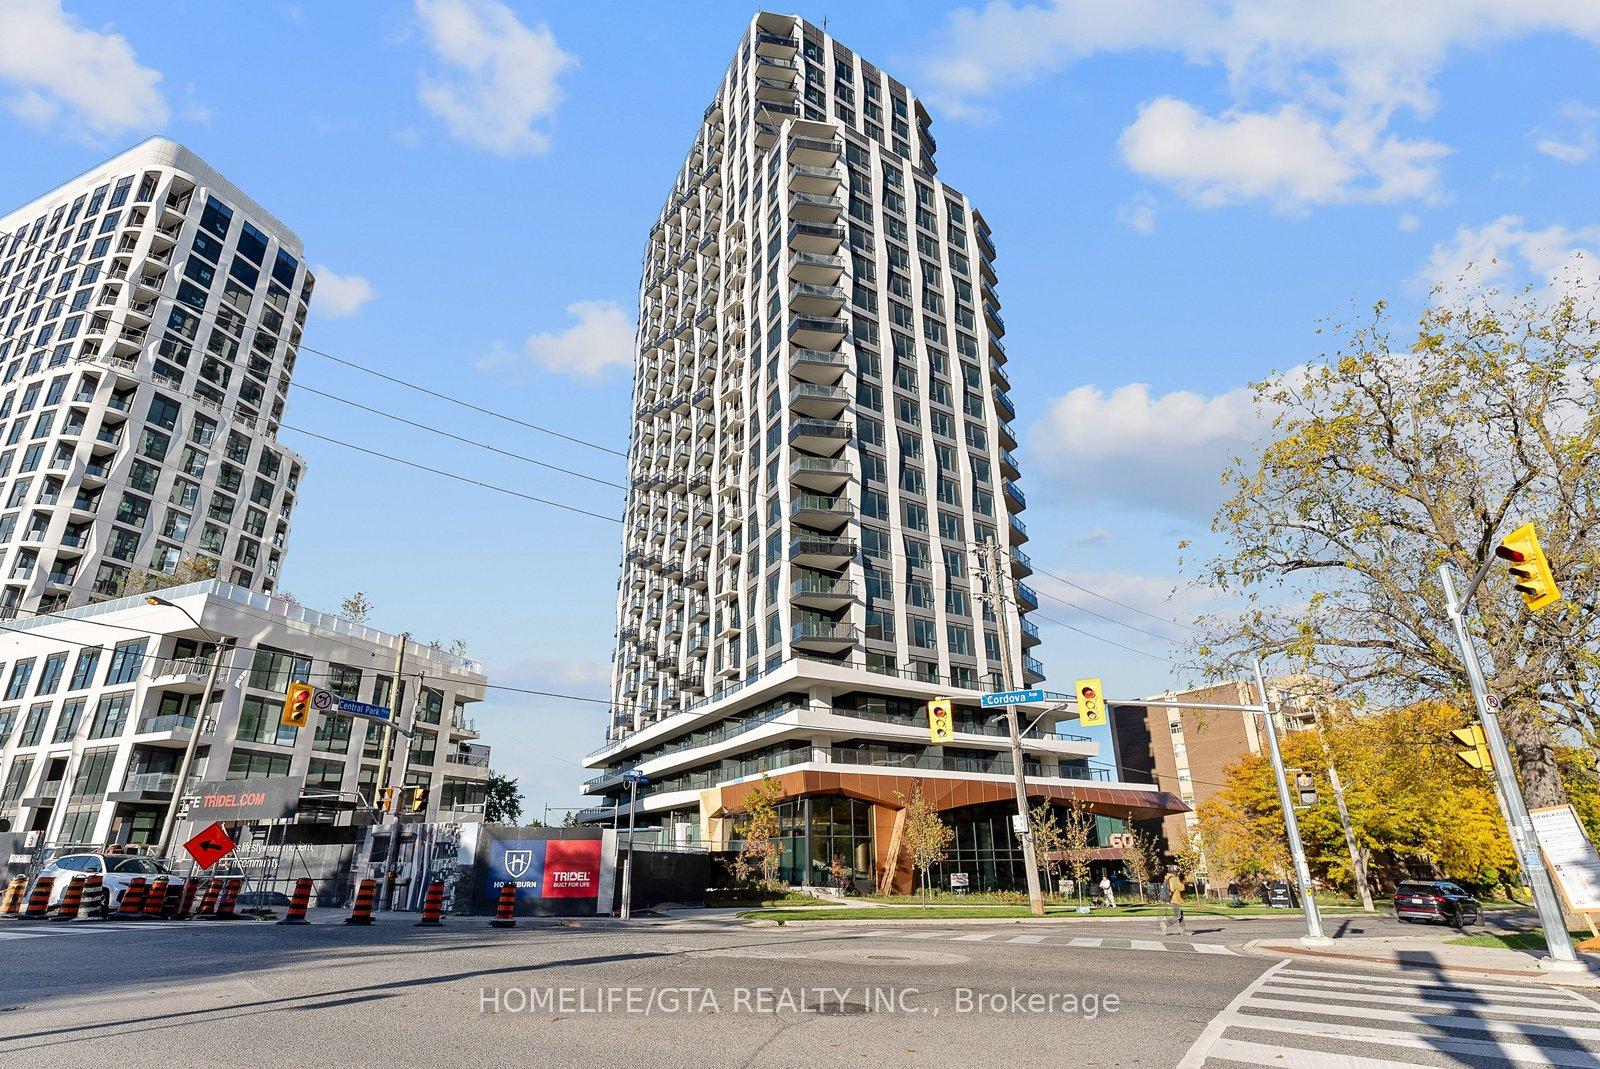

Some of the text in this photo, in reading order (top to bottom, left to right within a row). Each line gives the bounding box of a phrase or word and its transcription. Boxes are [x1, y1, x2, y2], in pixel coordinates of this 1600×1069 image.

[987, 694, 1026, 705] Cordova
[340, 700, 380, 716] Central Park
[203, 793, 266, 807] TRIDEL.COM
[553, 871, 590, 881] TRIDEL
